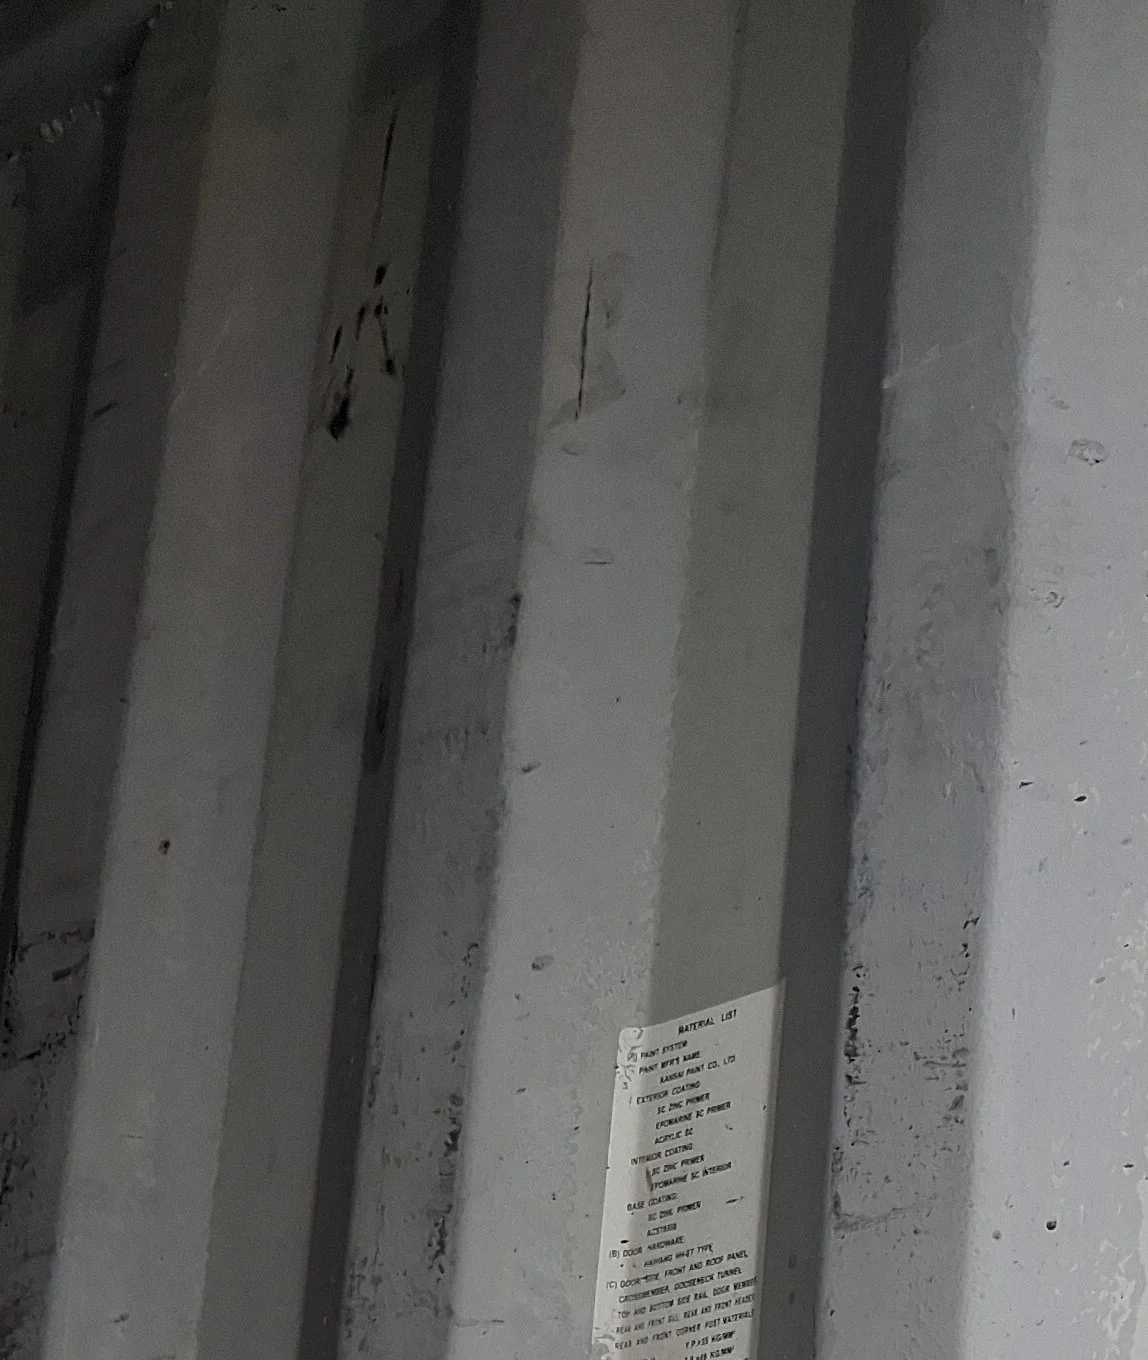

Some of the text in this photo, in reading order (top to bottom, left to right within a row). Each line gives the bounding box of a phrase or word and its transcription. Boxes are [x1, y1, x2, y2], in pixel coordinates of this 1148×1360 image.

[678, 1008, 737, 1035] MATERIAL LIST
[640, 1047, 660, 1060] PAINT
[662, 1040, 688, 1054] SYSTEM
[639, 1063, 658, 1075] PAINT
[660, 1070, 684, 1084] KANSAI
[686, 1064, 705, 1076] PAINT
[636, 1089, 669, 1105] EXTERIOR
[668, 1099, 683, 1112] ZINC
[686, 1092, 710, 1106] PRIMER
[707, 1101, 731, 1114] PRIMER
[655, 1131, 682, 1145] ACRYLIC
[630, 1151, 662, 1165] INTERIOR
[681, 1154, 705, 1167] PRIMER
[702, 1161, 732, 1177] INTERIOR
[677, 1200, 701, 1213] PRIMER
[622, 1246, 643, 1257] DOOR
[697, 1242, 714, 1253] TYPE
[606, 1279, 618, 1289] (C)
[664, 1265, 686, 1278] FRONT
[689, 1261, 703, 1272] AND
[705, 1254, 724, 1267] ROOF
[617, 1311, 631, 1323] TOP
[633, 1306, 647, 1317] AND
[649, 1300, 674, 1313] BOTTOM
[712, 1284, 730, 1297] DOOR
[615, 1323, 631, 1335] REAR
[633, 1322, 645, 1332] AND
[648, 1316, 666, 1327] FRONT
[684, 1308, 699, 1319] REAR
[701, 1305, 712, 1316] AND
[714, 1299, 733, 1312] FRONT
[615, 1338, 632, 1350] REAR
[636, 1335, 648, 1346] AND
[652, 1330, 672, 1341] FRONT
[676, 1323, 701, 1337] CORNER
[704, 1318, 721, 1329] POST
